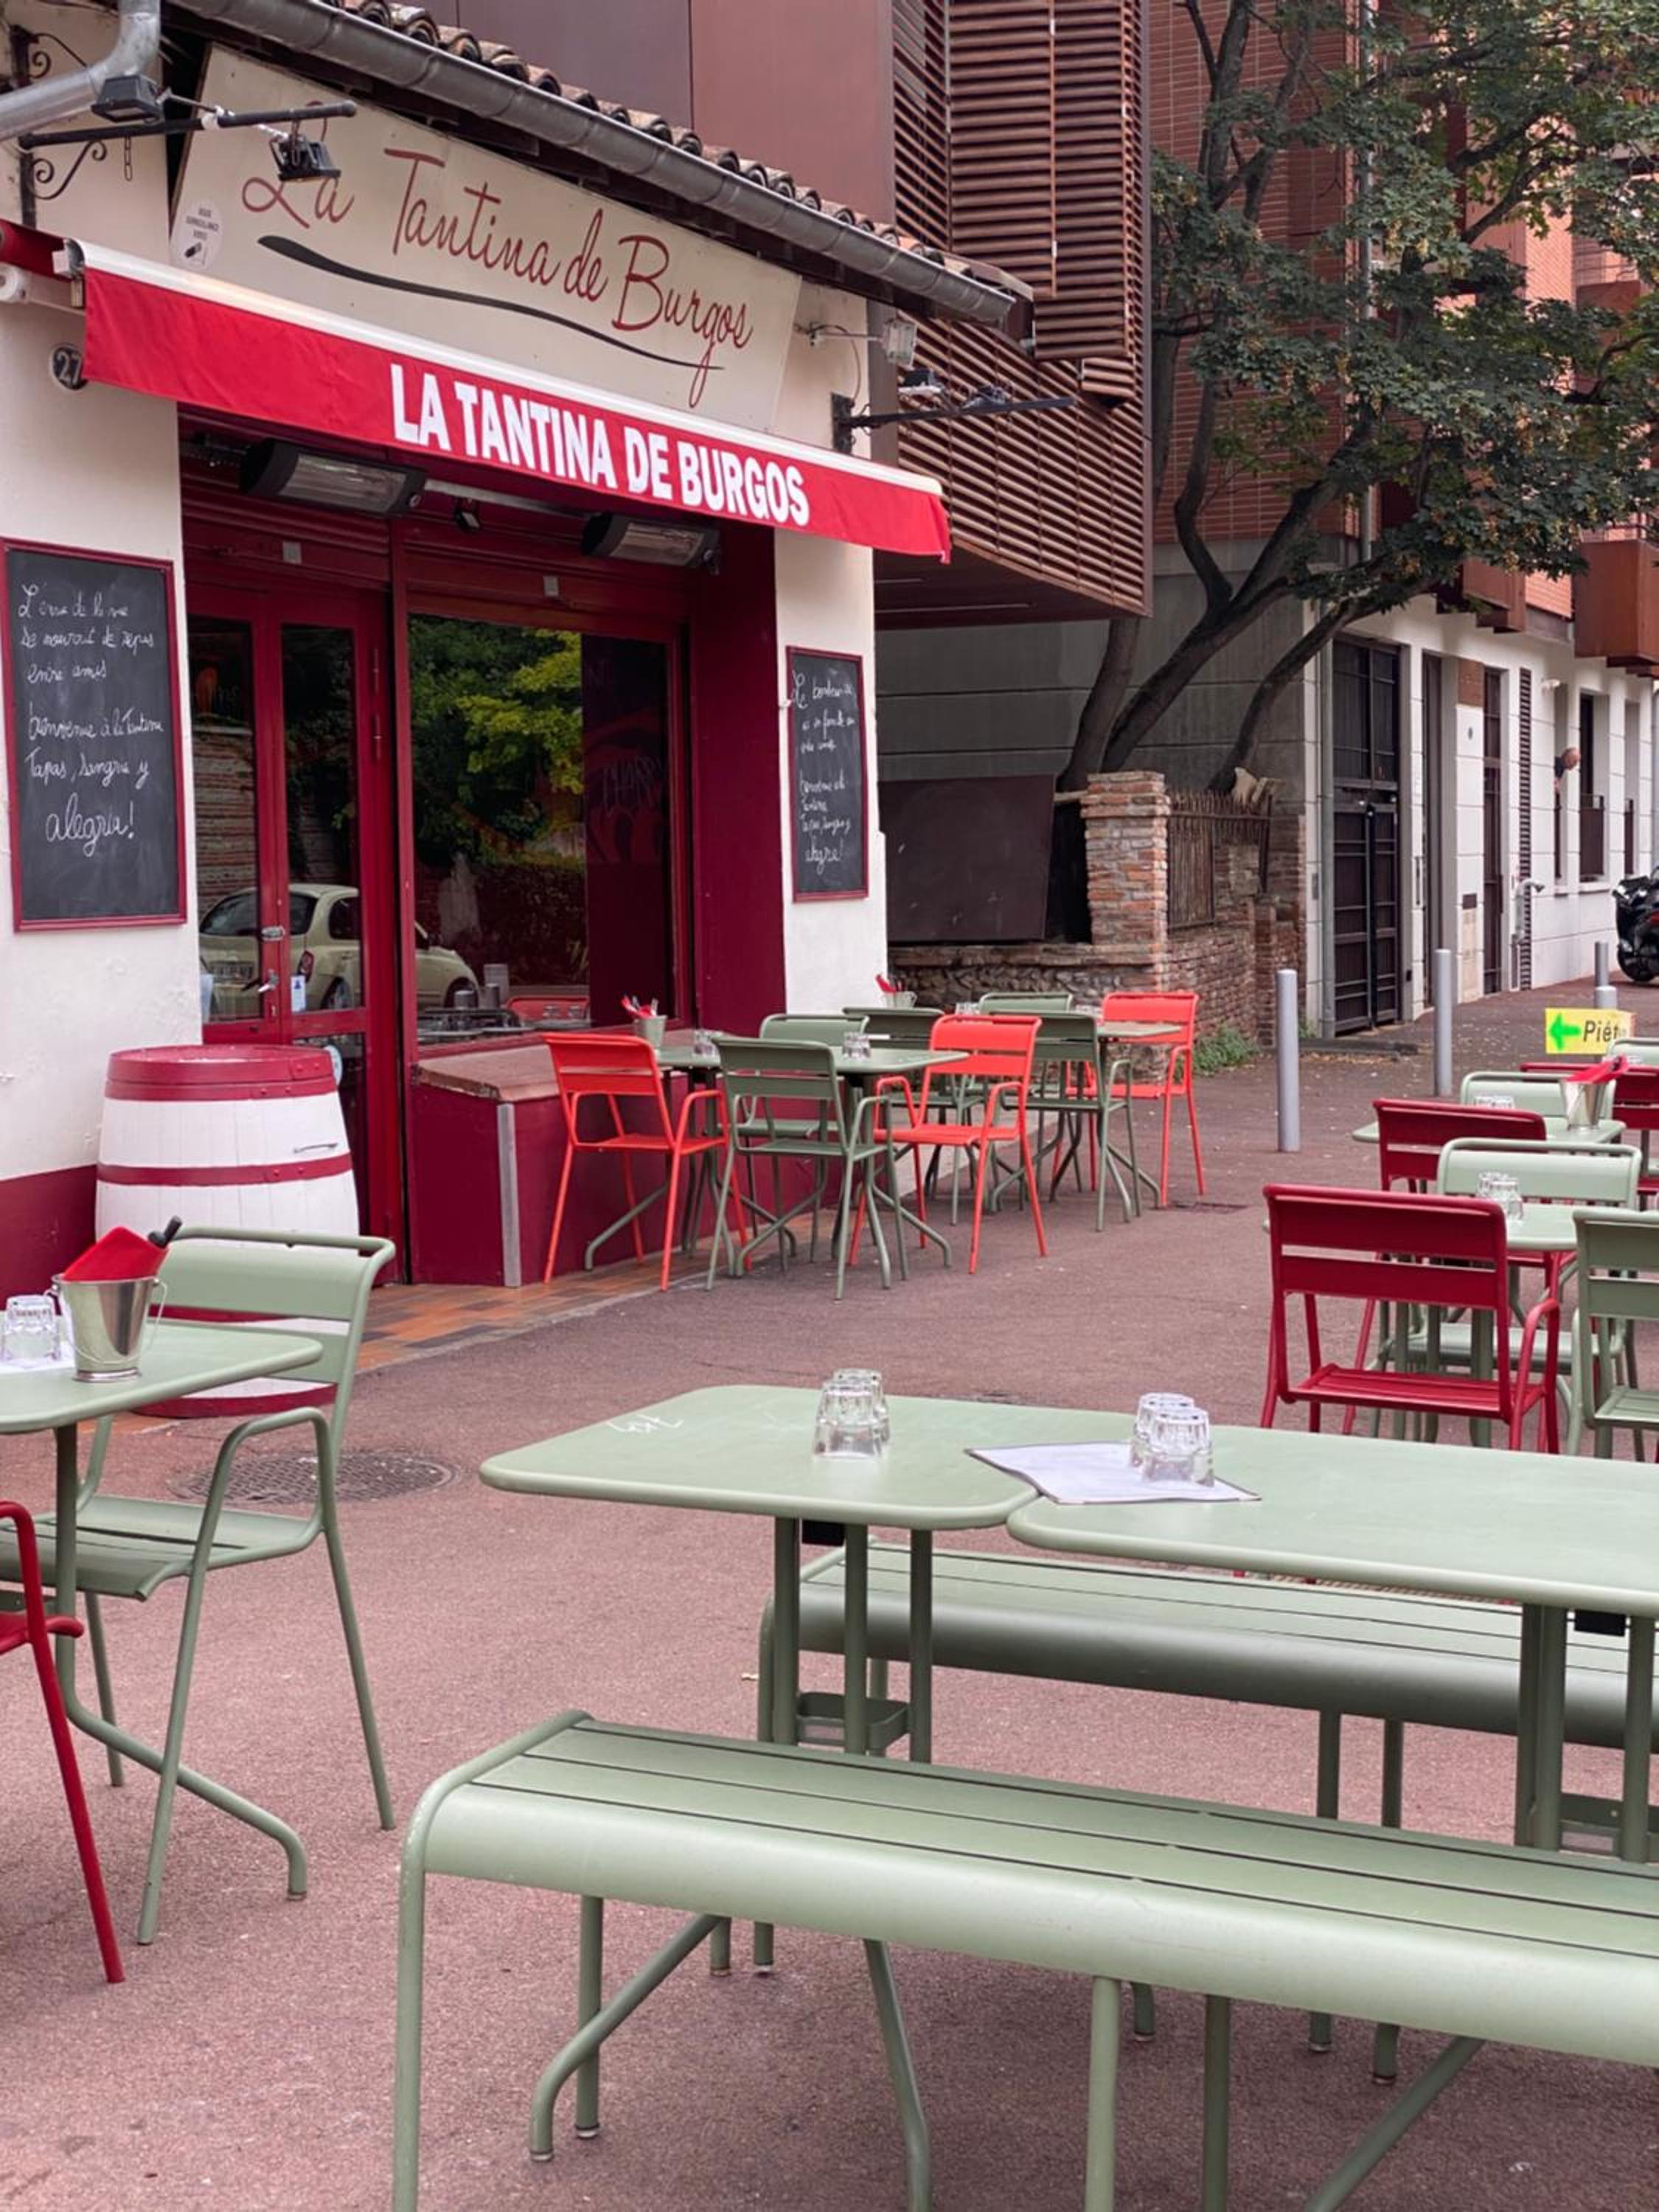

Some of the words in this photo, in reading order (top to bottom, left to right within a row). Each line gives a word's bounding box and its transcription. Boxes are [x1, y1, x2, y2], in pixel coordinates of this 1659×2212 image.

[241, 100, 355, 227] La
[383, 147, 562, 285] Tantina
[564, 209, 608, 302] de
[612, 234, 754, 408] Burgos
[57, 352, 83, 385] 27
[391, 364, 451, 452] LA
[454, 381, 617, 489] TANTINA
[623, 426, 673, 500] DE
[676, 441, 810, 526] BURGOS
